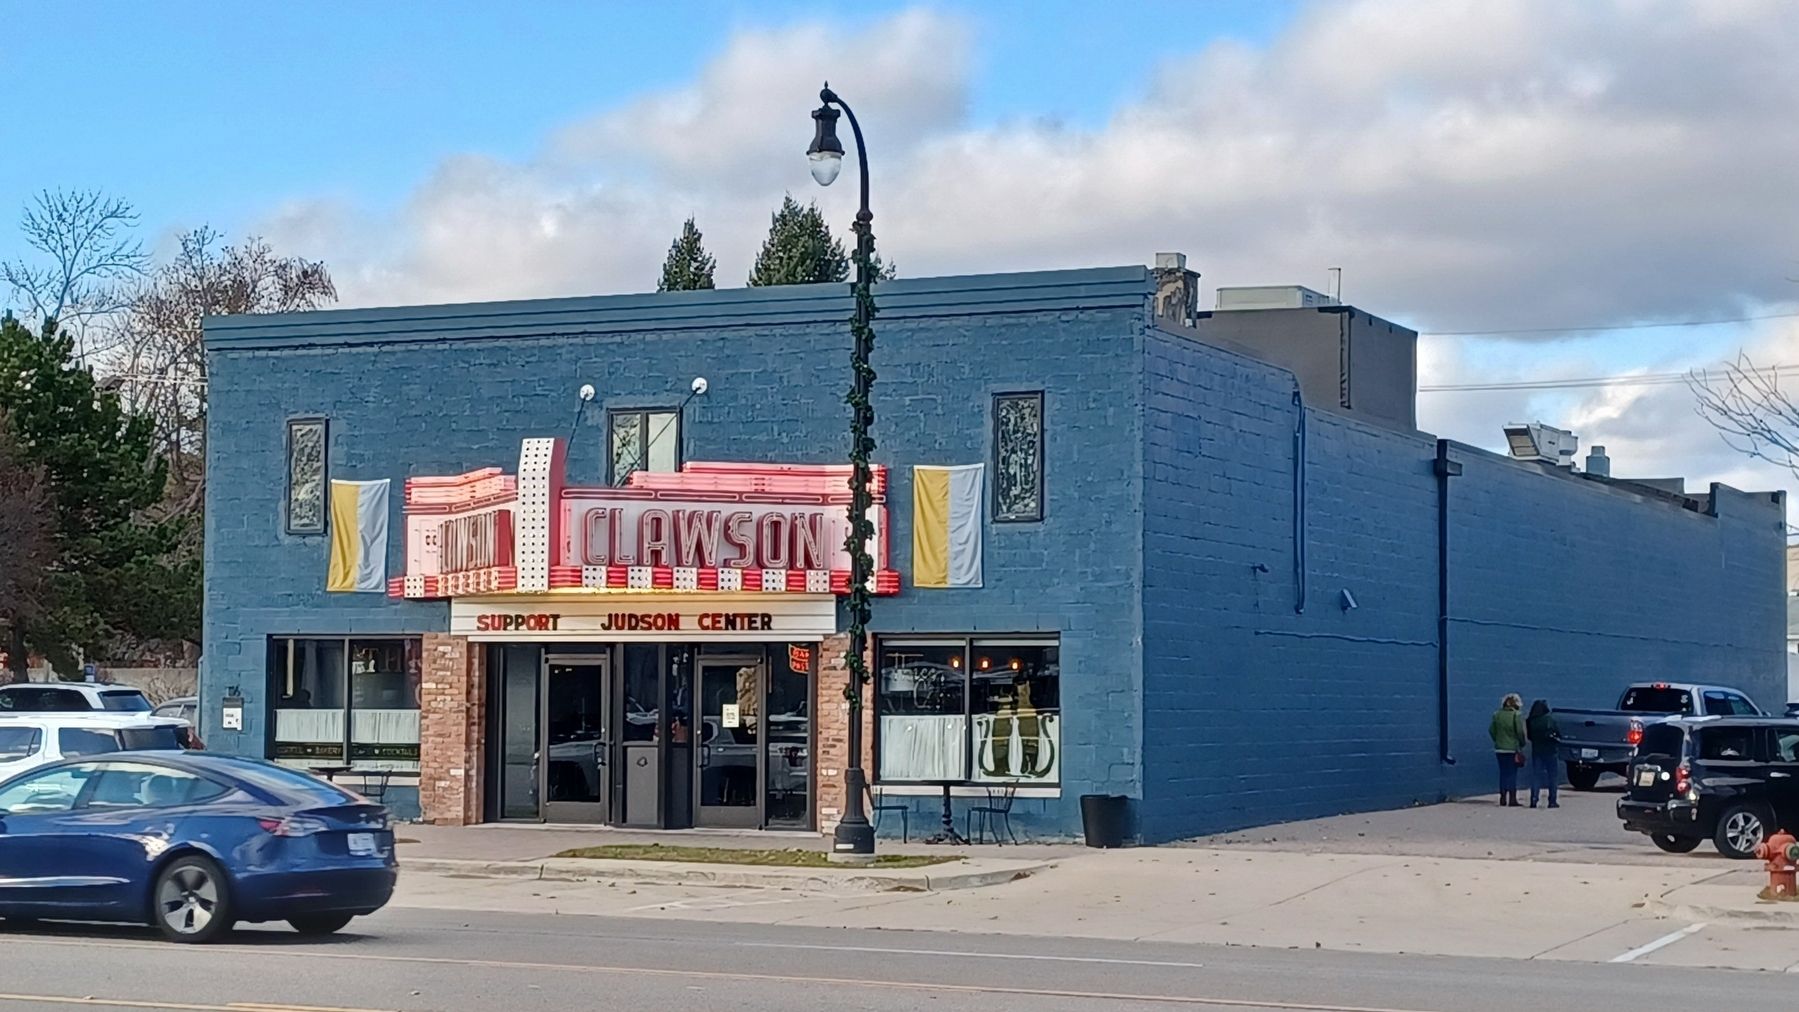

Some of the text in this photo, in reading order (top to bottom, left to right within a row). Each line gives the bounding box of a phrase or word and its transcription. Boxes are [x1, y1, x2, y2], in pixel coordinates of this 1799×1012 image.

[581, 507, 825, 569] CLAWSON
[476, 613, 773, 631] SUPPORT JUDSON CENTER
